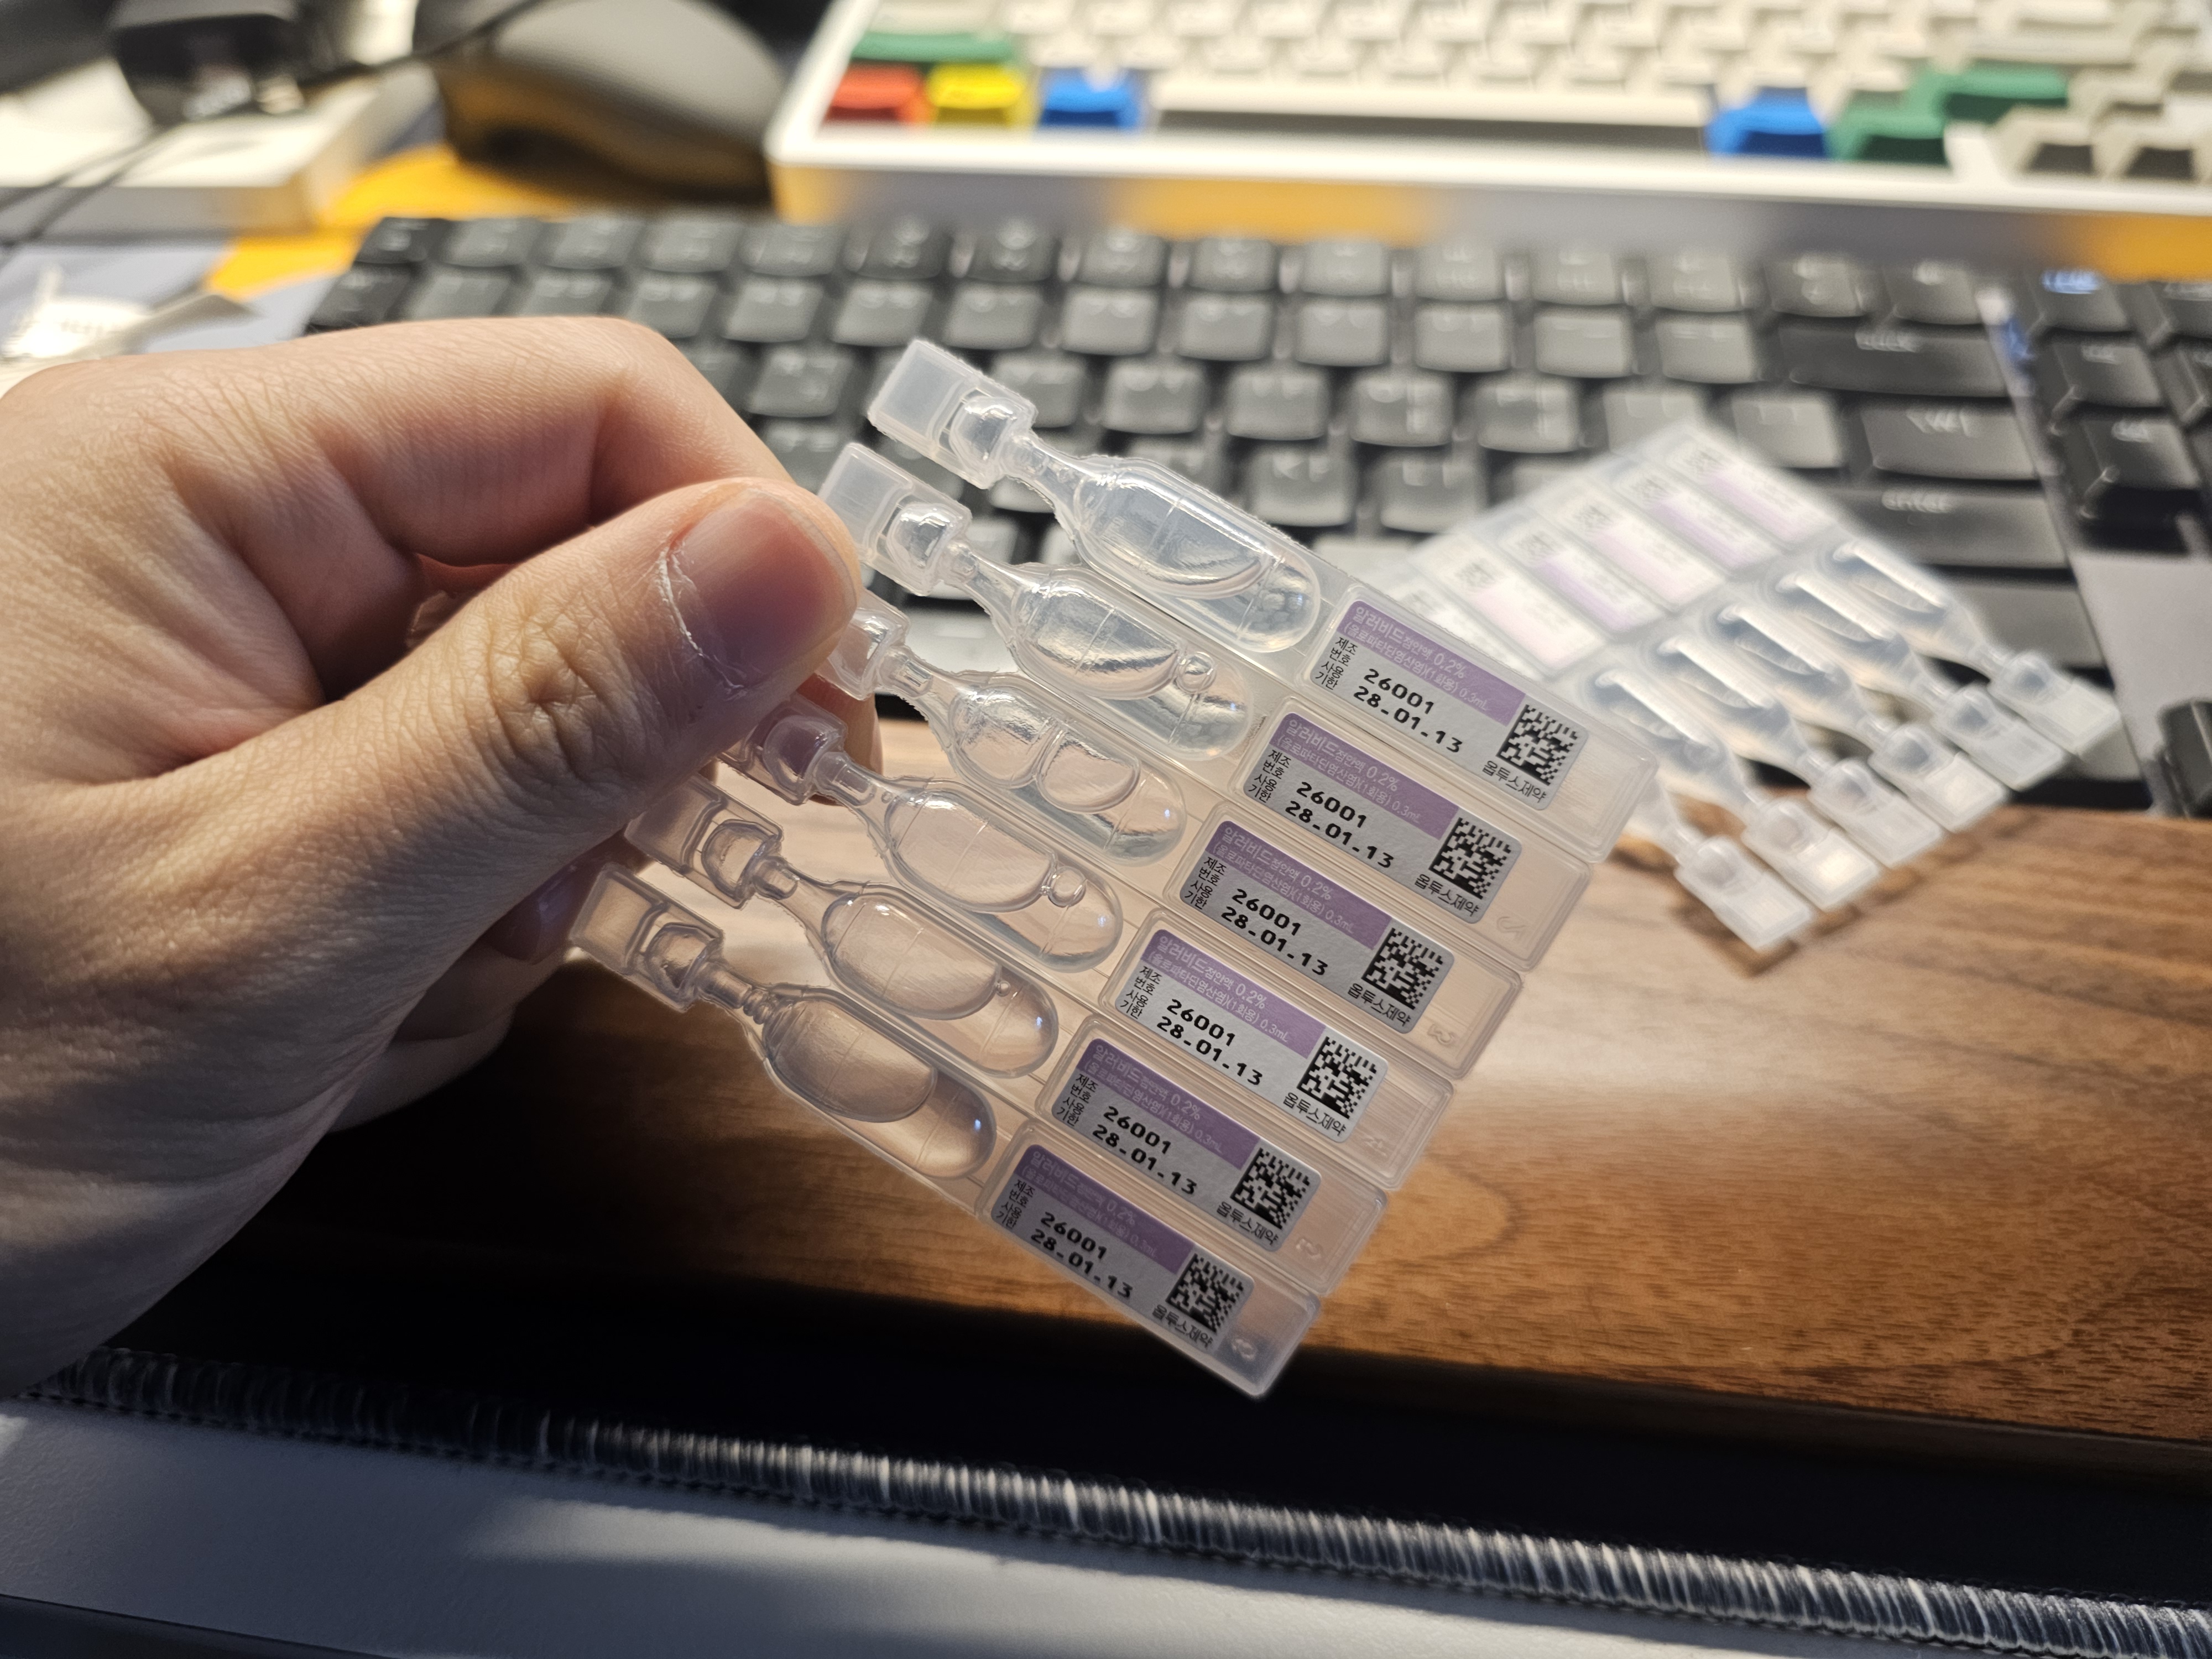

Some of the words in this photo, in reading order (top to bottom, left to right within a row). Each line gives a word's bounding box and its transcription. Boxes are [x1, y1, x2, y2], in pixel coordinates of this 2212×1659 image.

[1334, 637, 1358, 656] 제조
[1352, 606, 1434, 660] 알러비드점안액
[1433, 653, 1466, 679] 0.2%
[1329, 646, 1351, 667] 번호
[1314, 671, 1339, 691] 기한
[1320, 660, 1344, 680] 사용
[1363, 668, 1434, 715] 26001
[1459, 687, 1488, 711] 0.3mL
[1353, 685, 1463, 753] 28-01-13
[1267, 749, 1292, 769] 제조
[1285, 718, 1368, 773] 알러비드점안액
[1366, 765, 1400, 791] 0.2%
[1261, 759, 1285, 780] 번호
[1253, 773, 1278, 792] 사용
[1481, 760, 1547, 804] 옵투스제약
[1248, 784, 1272, 804] 기한
[1296, 781, 1368, 829] 26001
[1284, 800, 1395, 869] 28-01-13
[1197, 866, 1220, 887] 번호
[1203, 856, 1227, 876] 제조
[1190, 879, 1214, 899] 사용
[1300, 874, 1333, 901] 0.2%
[1413, 873, 1480, 917] 옵투스제약
[1183, 890, 1208, 910] 기한
[1231, 888, 1302, 937] 26001
[1326, 910, 1353, 933] 0.3mL
[1220, 906, 1329, 976] 28-01-13
[1139, 965, 1162, 985] 제조
[1156, 935, 1237, 990] 알러비드점안액
[1235, 983, 1267, 1009] 0.2%
[1133, 976, 1156, 996] 번호
[1119, 999, 1143, 1020] 기한
[1125, 989, 1149, 1008] 사용
[1347, 983, 1412, 1027] 옵투스제약
[1166, 998, 1236, 1047] 26001
[1260, 1019, 1288, 1042] 0.3mL
[1156, 1015, 1263, 1086] 28-01-13
[1070, 1083, 1092, 1104] 번호
[1075, 1073, 1098, 1093] 제조
[1056, 1106, 1079, 1127] 기한
[1062, 1096, 1085, 1116] 사용
[1170, 1093, 1202, 1120] 0.2%
[1282, 1092, 1347, 1137] 옵투스제약
[1103, 1105, 1172, 1155] 26001
[1092, 1124, 1197, 1196] 28-01-13
[1008, 1188, 1029, 1209] 번호
[1014, 1179, 1036, 1198] 제조
[995, 1211, 1018, 1230] 기한
[1000, 1201, 1022, 1220] 사용
[1106, 1200, 1138, 1226] 0.2%
[1215, 1201, 1279, 1246] 옵투스제약
[1040, 1211, 1107, 1260] 26001
[1030, 1228, 1133, 1299] 28-01-13
[1151, 1304, 1214, 1349] 옵투스제약
